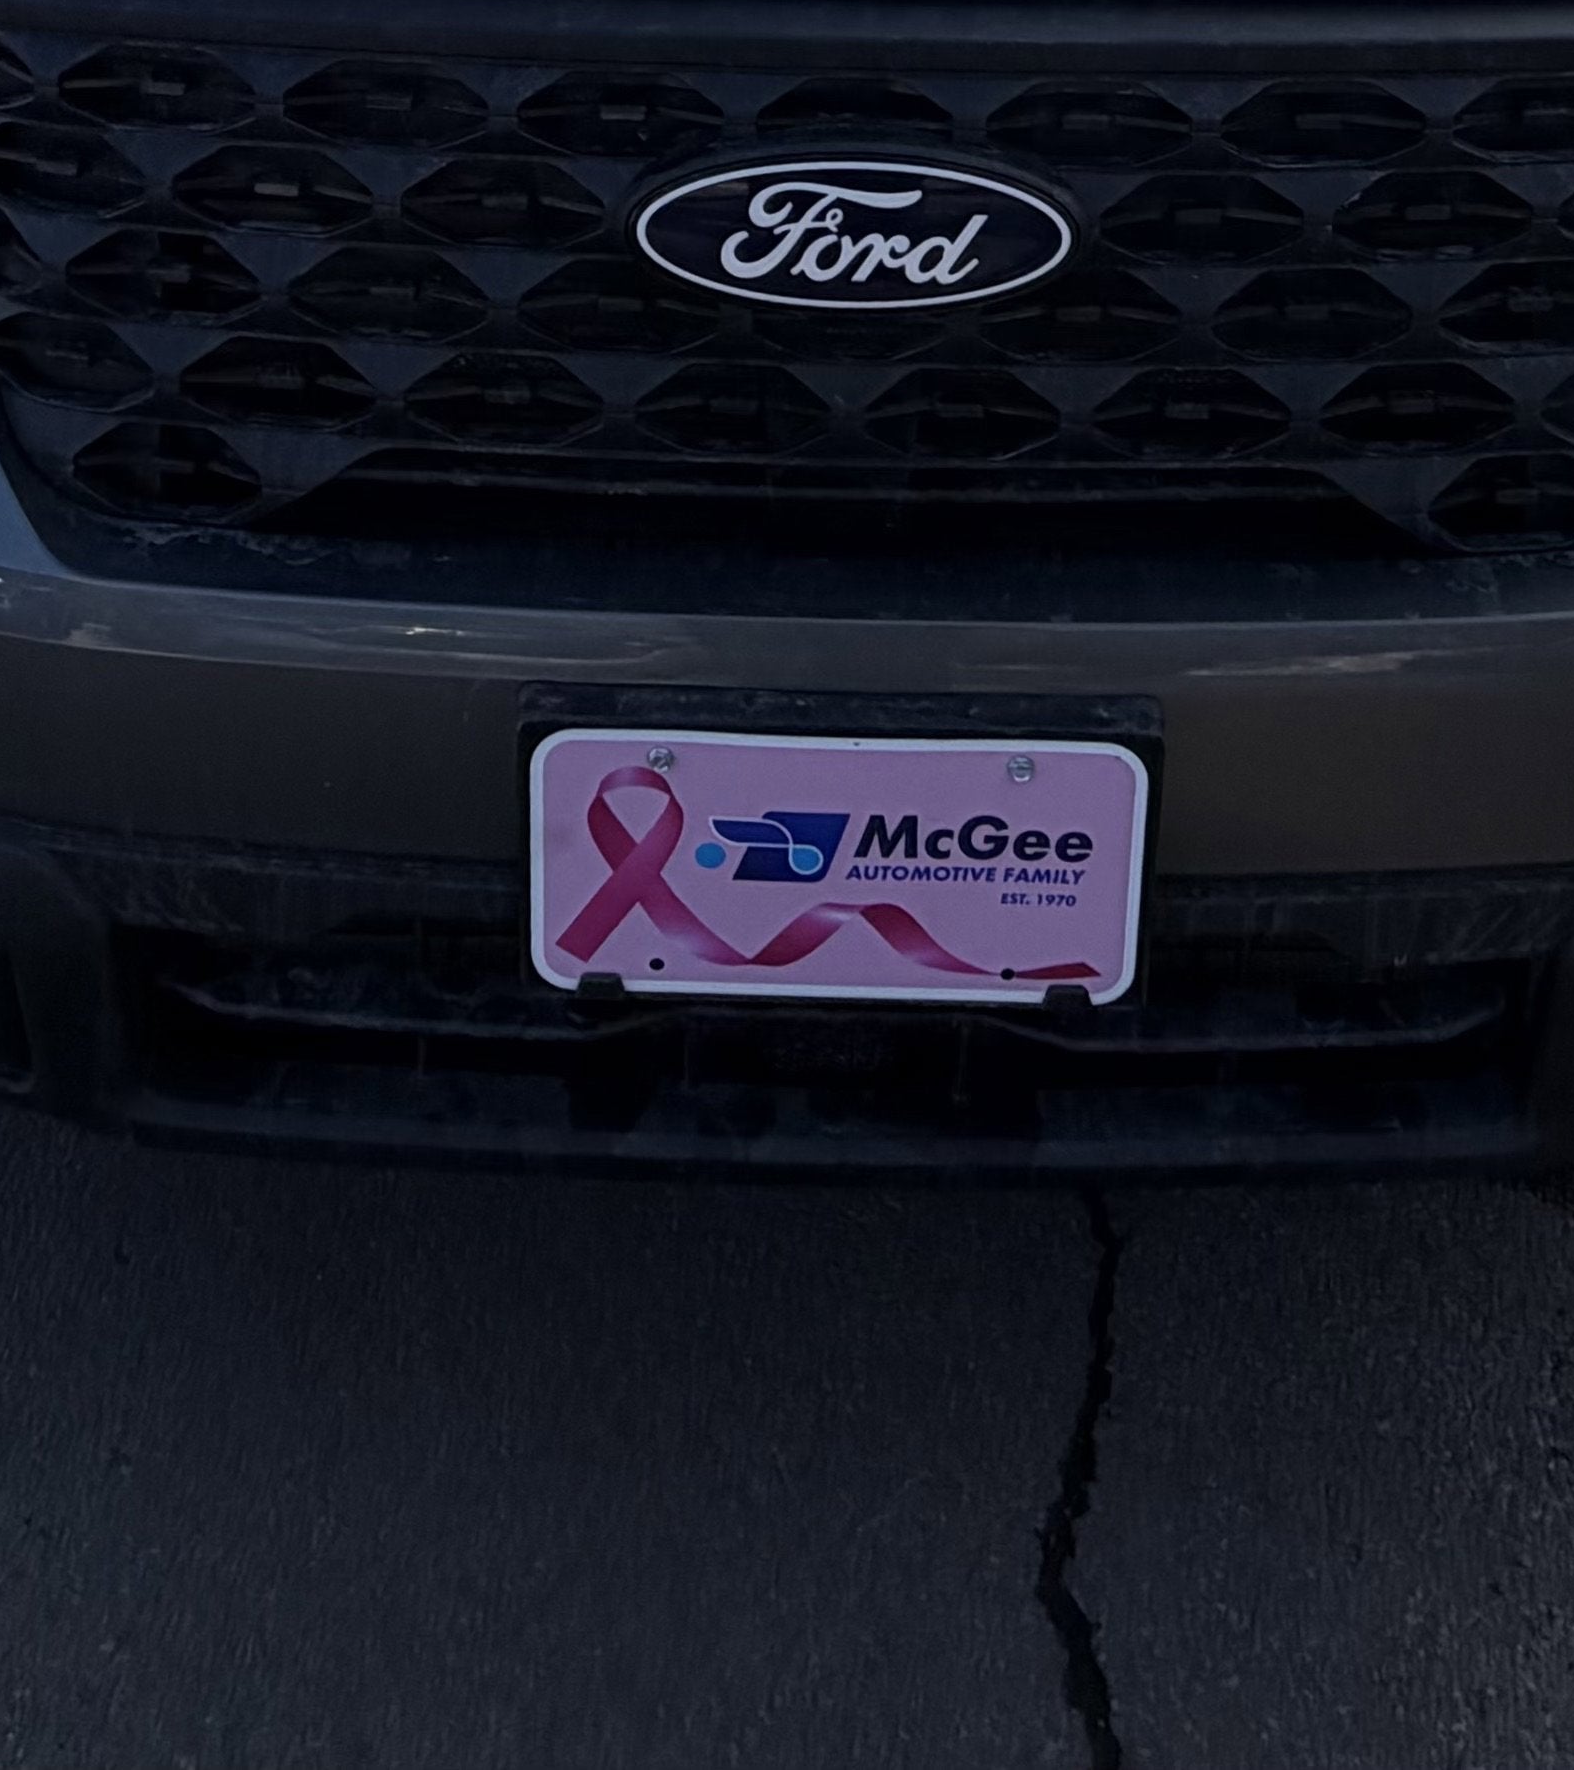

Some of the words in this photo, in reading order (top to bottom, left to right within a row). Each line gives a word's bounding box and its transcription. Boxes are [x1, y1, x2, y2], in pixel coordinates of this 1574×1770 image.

[721, 182, 988, 285] Ford
[853, 814, 1093, 863] McGee
[845, 865, 997, 883] AUTOMOTIVE
[1003, 867, 1086, 885] FAMILY
[1000, 892, 1030, 906] EST.
[1037, 893, 1076, 907] 1970
